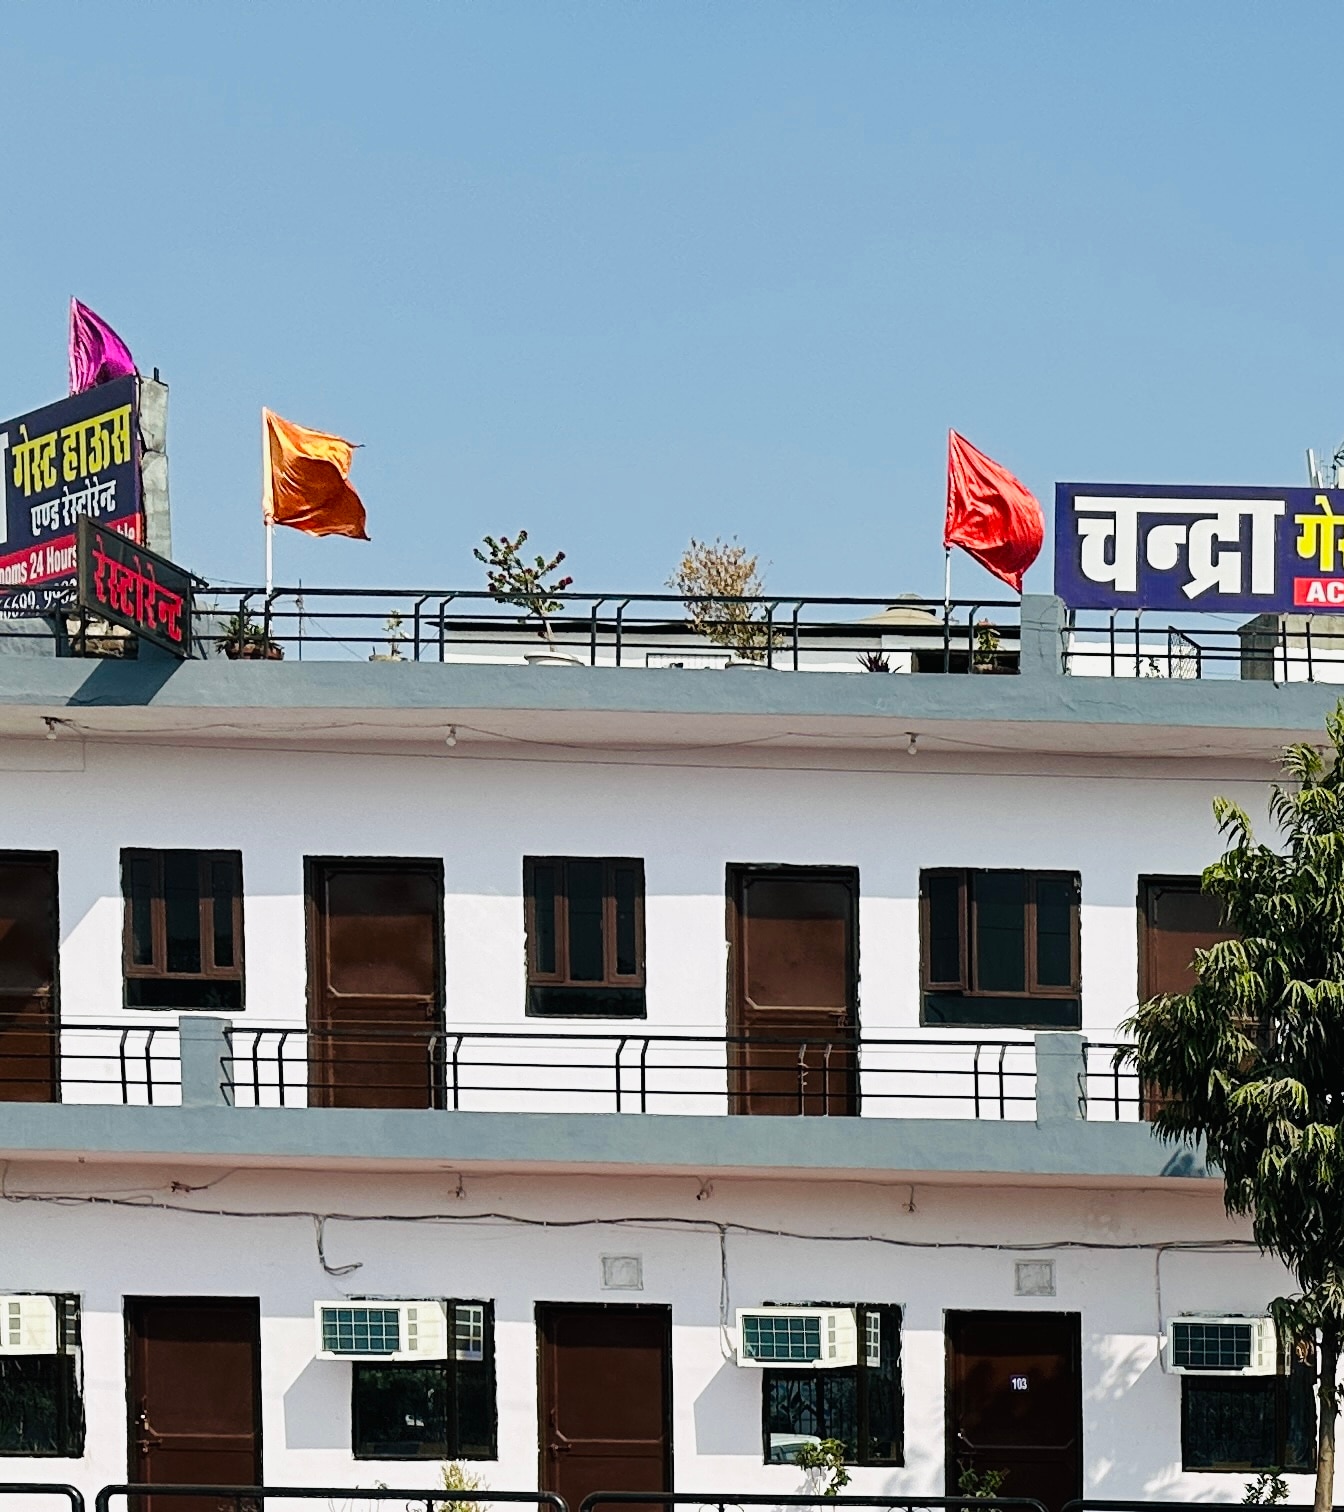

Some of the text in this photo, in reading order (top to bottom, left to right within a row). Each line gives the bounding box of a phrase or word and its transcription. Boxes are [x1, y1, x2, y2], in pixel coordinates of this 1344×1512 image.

[12, 424, 57, 496] गेस्ट
[61, 404, 132, 481] हाऊस
[31, 500, 61, 536] एण्ड
[1074, 496, 1286, 600] चन्द्रा
[0, 561, 27, 585] ooms
[30, 550, 44, 579] 24
[92, 534, 183, 642] रेस्टोरेन्ट
[1306, 581, 1344, 604] AC
